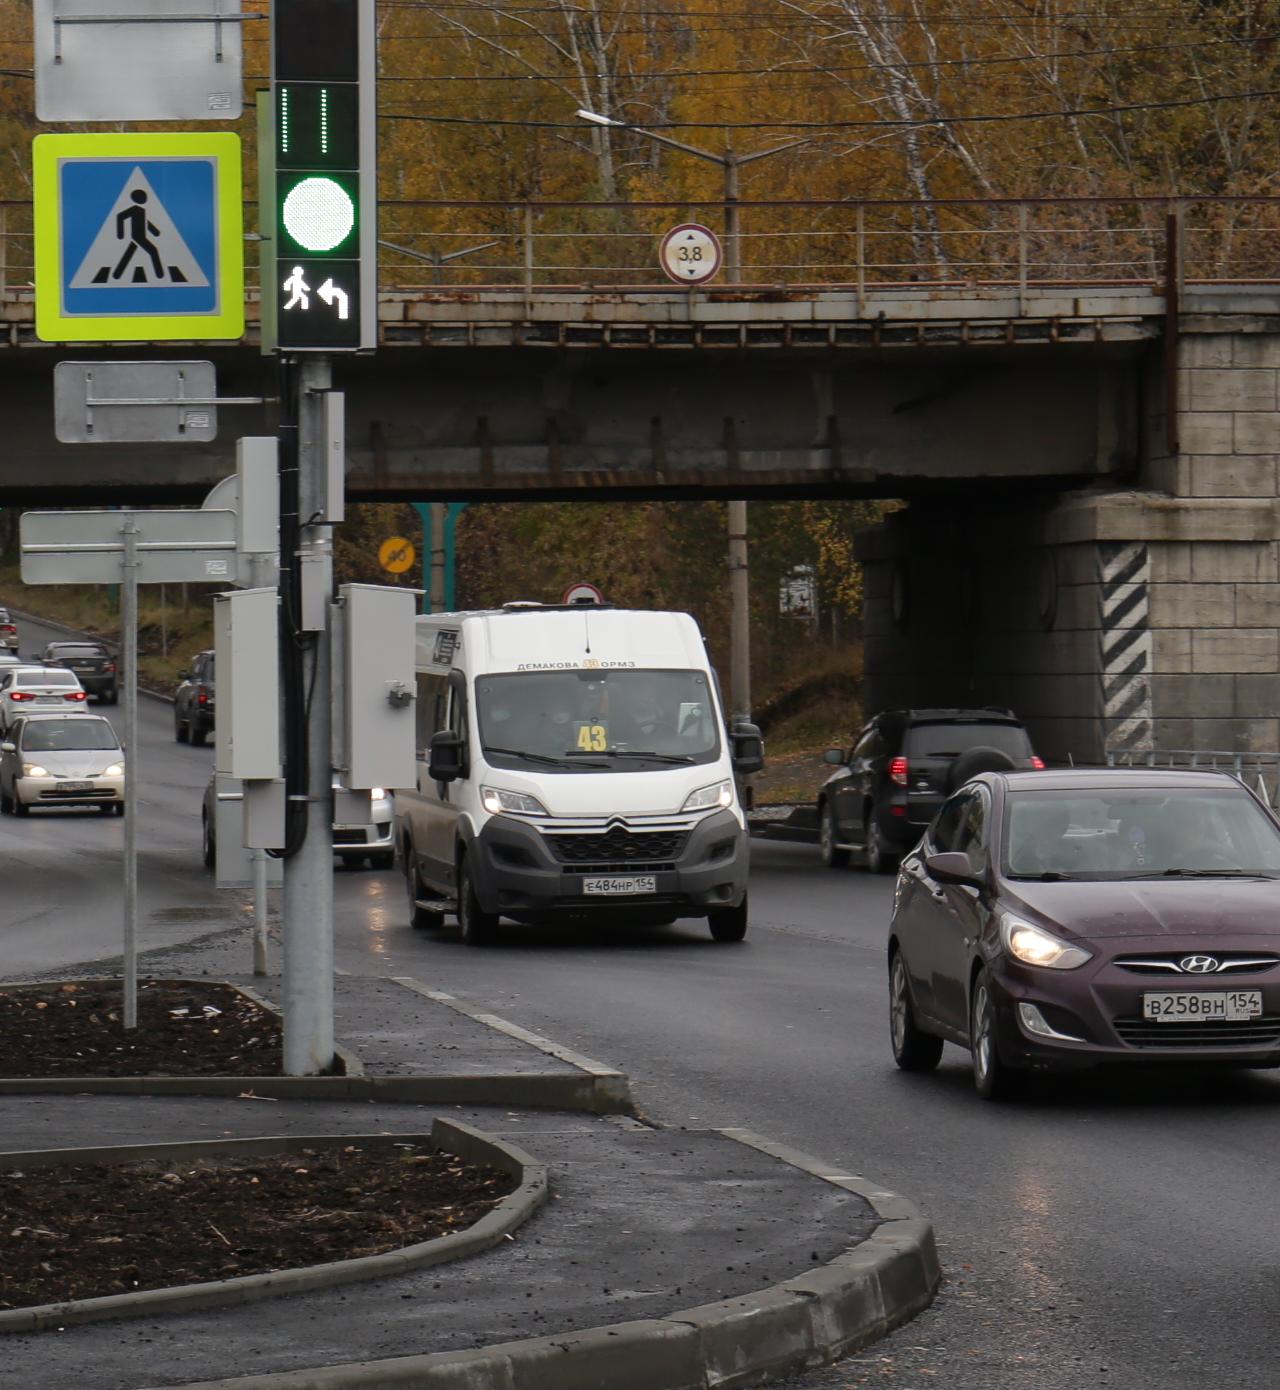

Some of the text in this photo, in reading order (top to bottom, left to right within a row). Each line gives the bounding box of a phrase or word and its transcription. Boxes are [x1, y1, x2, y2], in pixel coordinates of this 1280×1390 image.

[678, 246, 703, 264] 3,8
[516, 661, 579, 671] ДЕМАКОВА
[577, 725, 607, 752] 43
